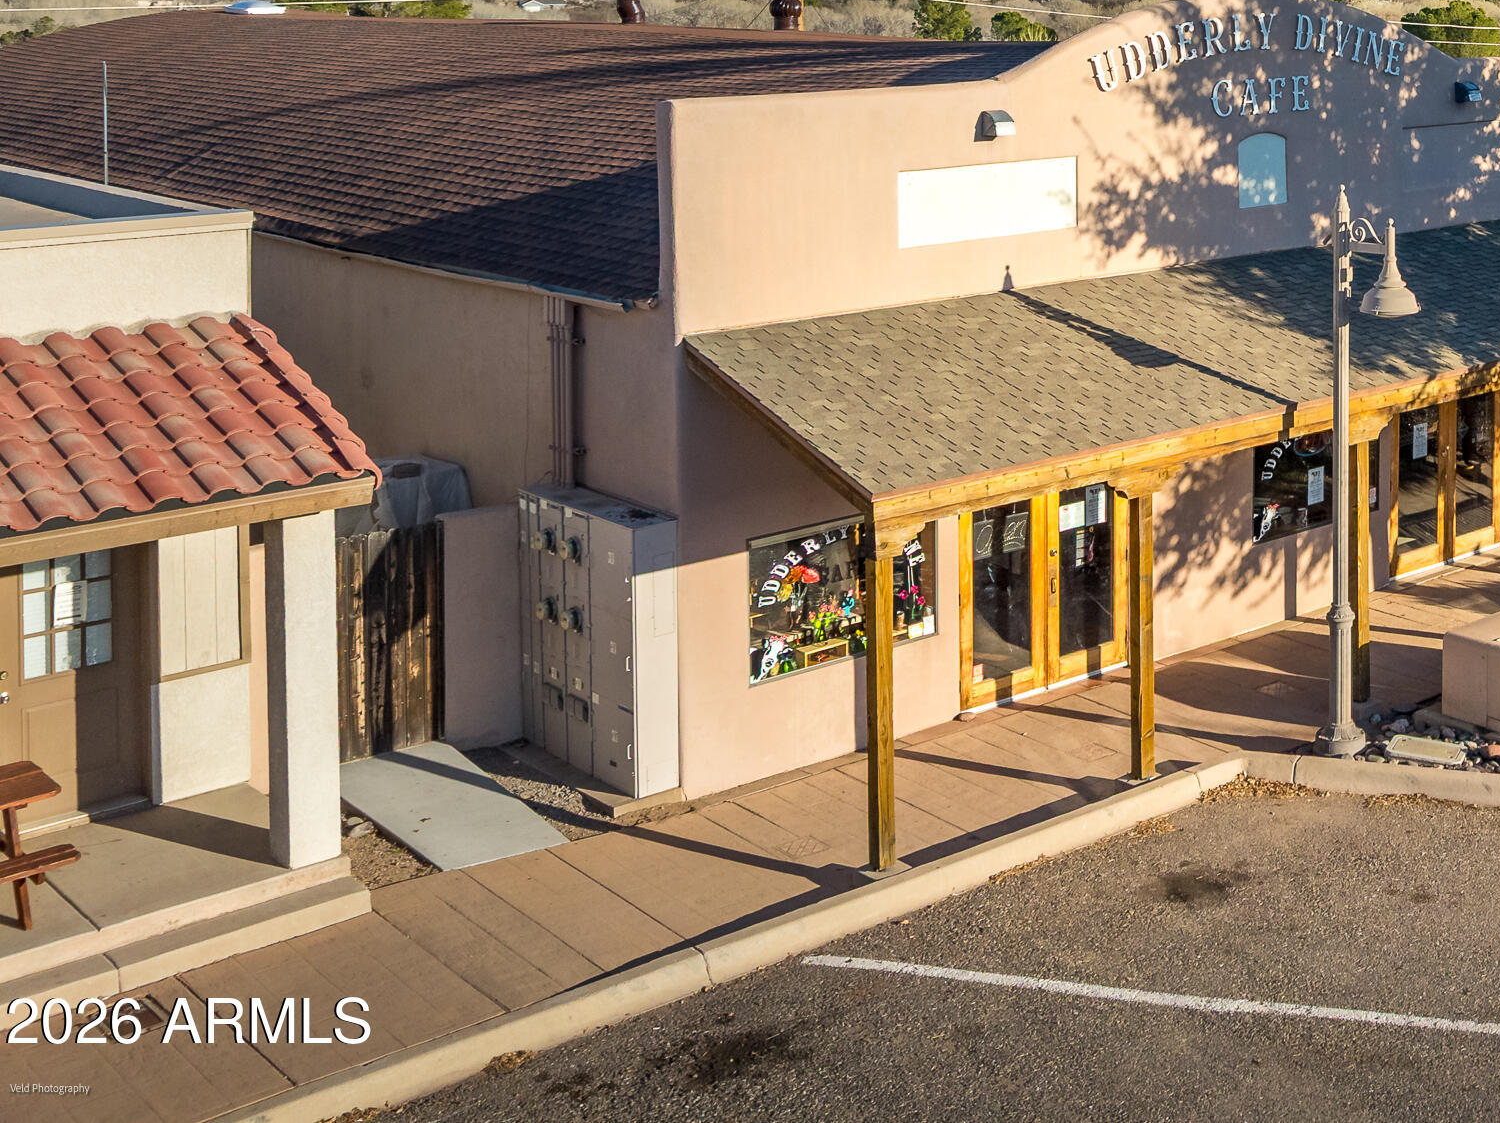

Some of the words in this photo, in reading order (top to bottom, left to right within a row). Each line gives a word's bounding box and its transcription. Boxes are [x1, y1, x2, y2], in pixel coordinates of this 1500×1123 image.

[1088, 13, 1276, 92] UDDERLY
[1294, 13, 1404, 76] DIVINE
[1211, 75, 1310, 117] CAFE
[1261, 436, 1301, 481] UDDE
[758, 524, 850, 608] UDDERLY
